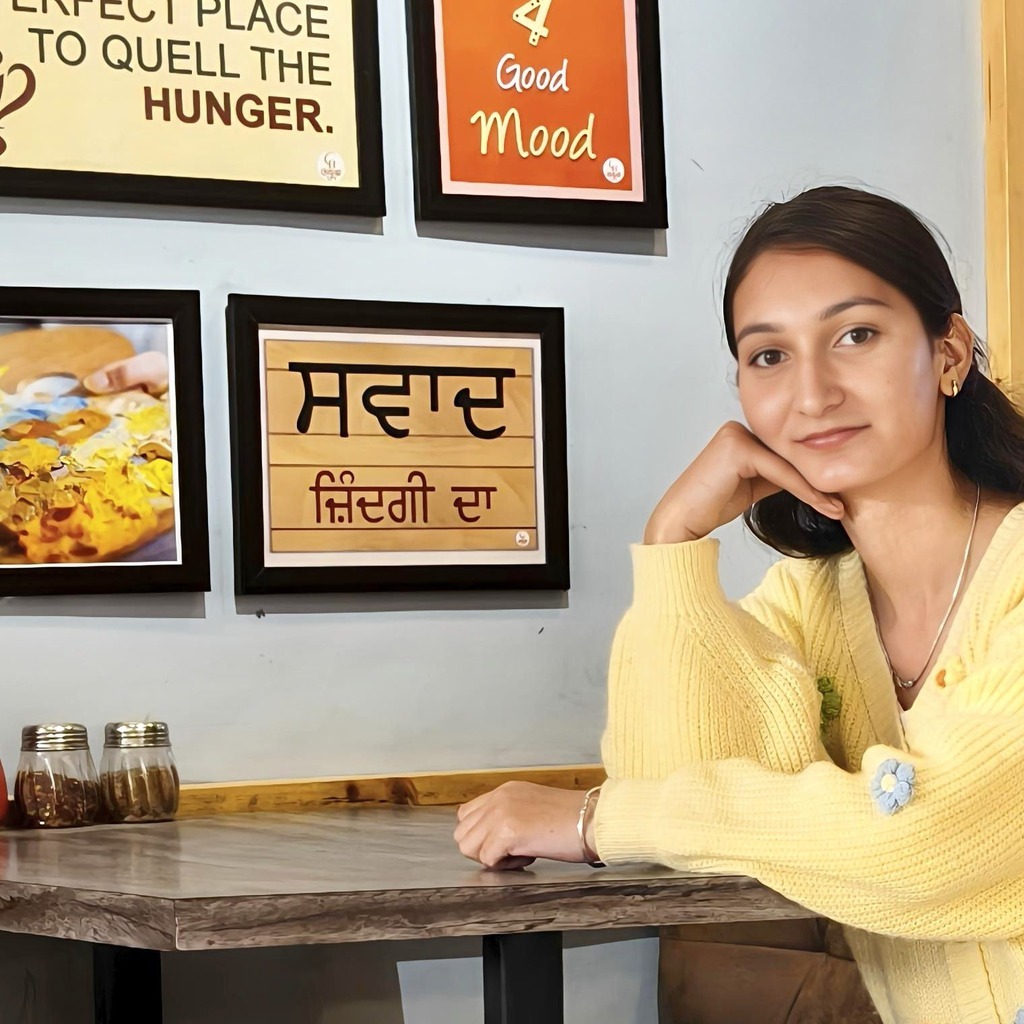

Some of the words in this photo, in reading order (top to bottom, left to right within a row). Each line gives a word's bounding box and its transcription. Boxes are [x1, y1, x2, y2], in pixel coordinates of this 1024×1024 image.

[198, 0, 331, 39] PLACE
[512, 0, 552, 47] 4
[28, 27, 87, 67] TO
[102, 34, 241, 79] QUELL
[250, 45, 333, 87] THE
[496, 52, 570, 93] Good
[143, 86, 334, 134] HUNGER.
[469, 107, 597, 161] Mood
[288, 361, 516, 440] ਸਵਾਦ
[309, 470, 436, 524] ਜ਼ਿੰਦਗੀ
[451, 486, 498, 523] ਦਾ
